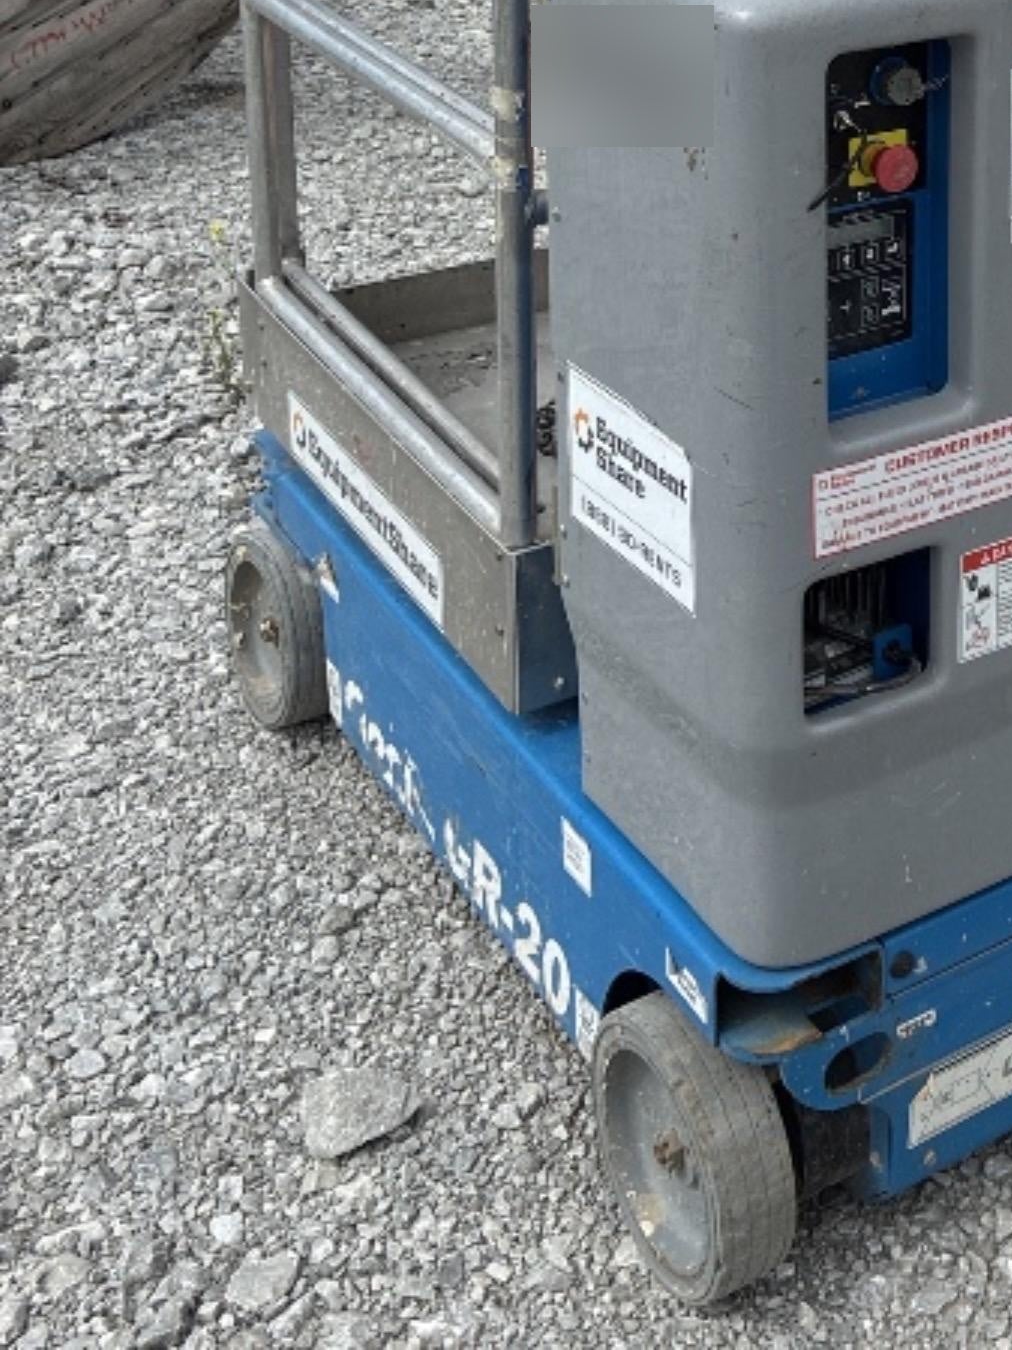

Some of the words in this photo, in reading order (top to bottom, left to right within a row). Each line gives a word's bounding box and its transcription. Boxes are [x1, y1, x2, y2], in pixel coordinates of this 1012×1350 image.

[596, 416, 688, 504] Equipment
[596, 446, 646, 499] Share
[885, 438, 970, 473] CUSTOMER
